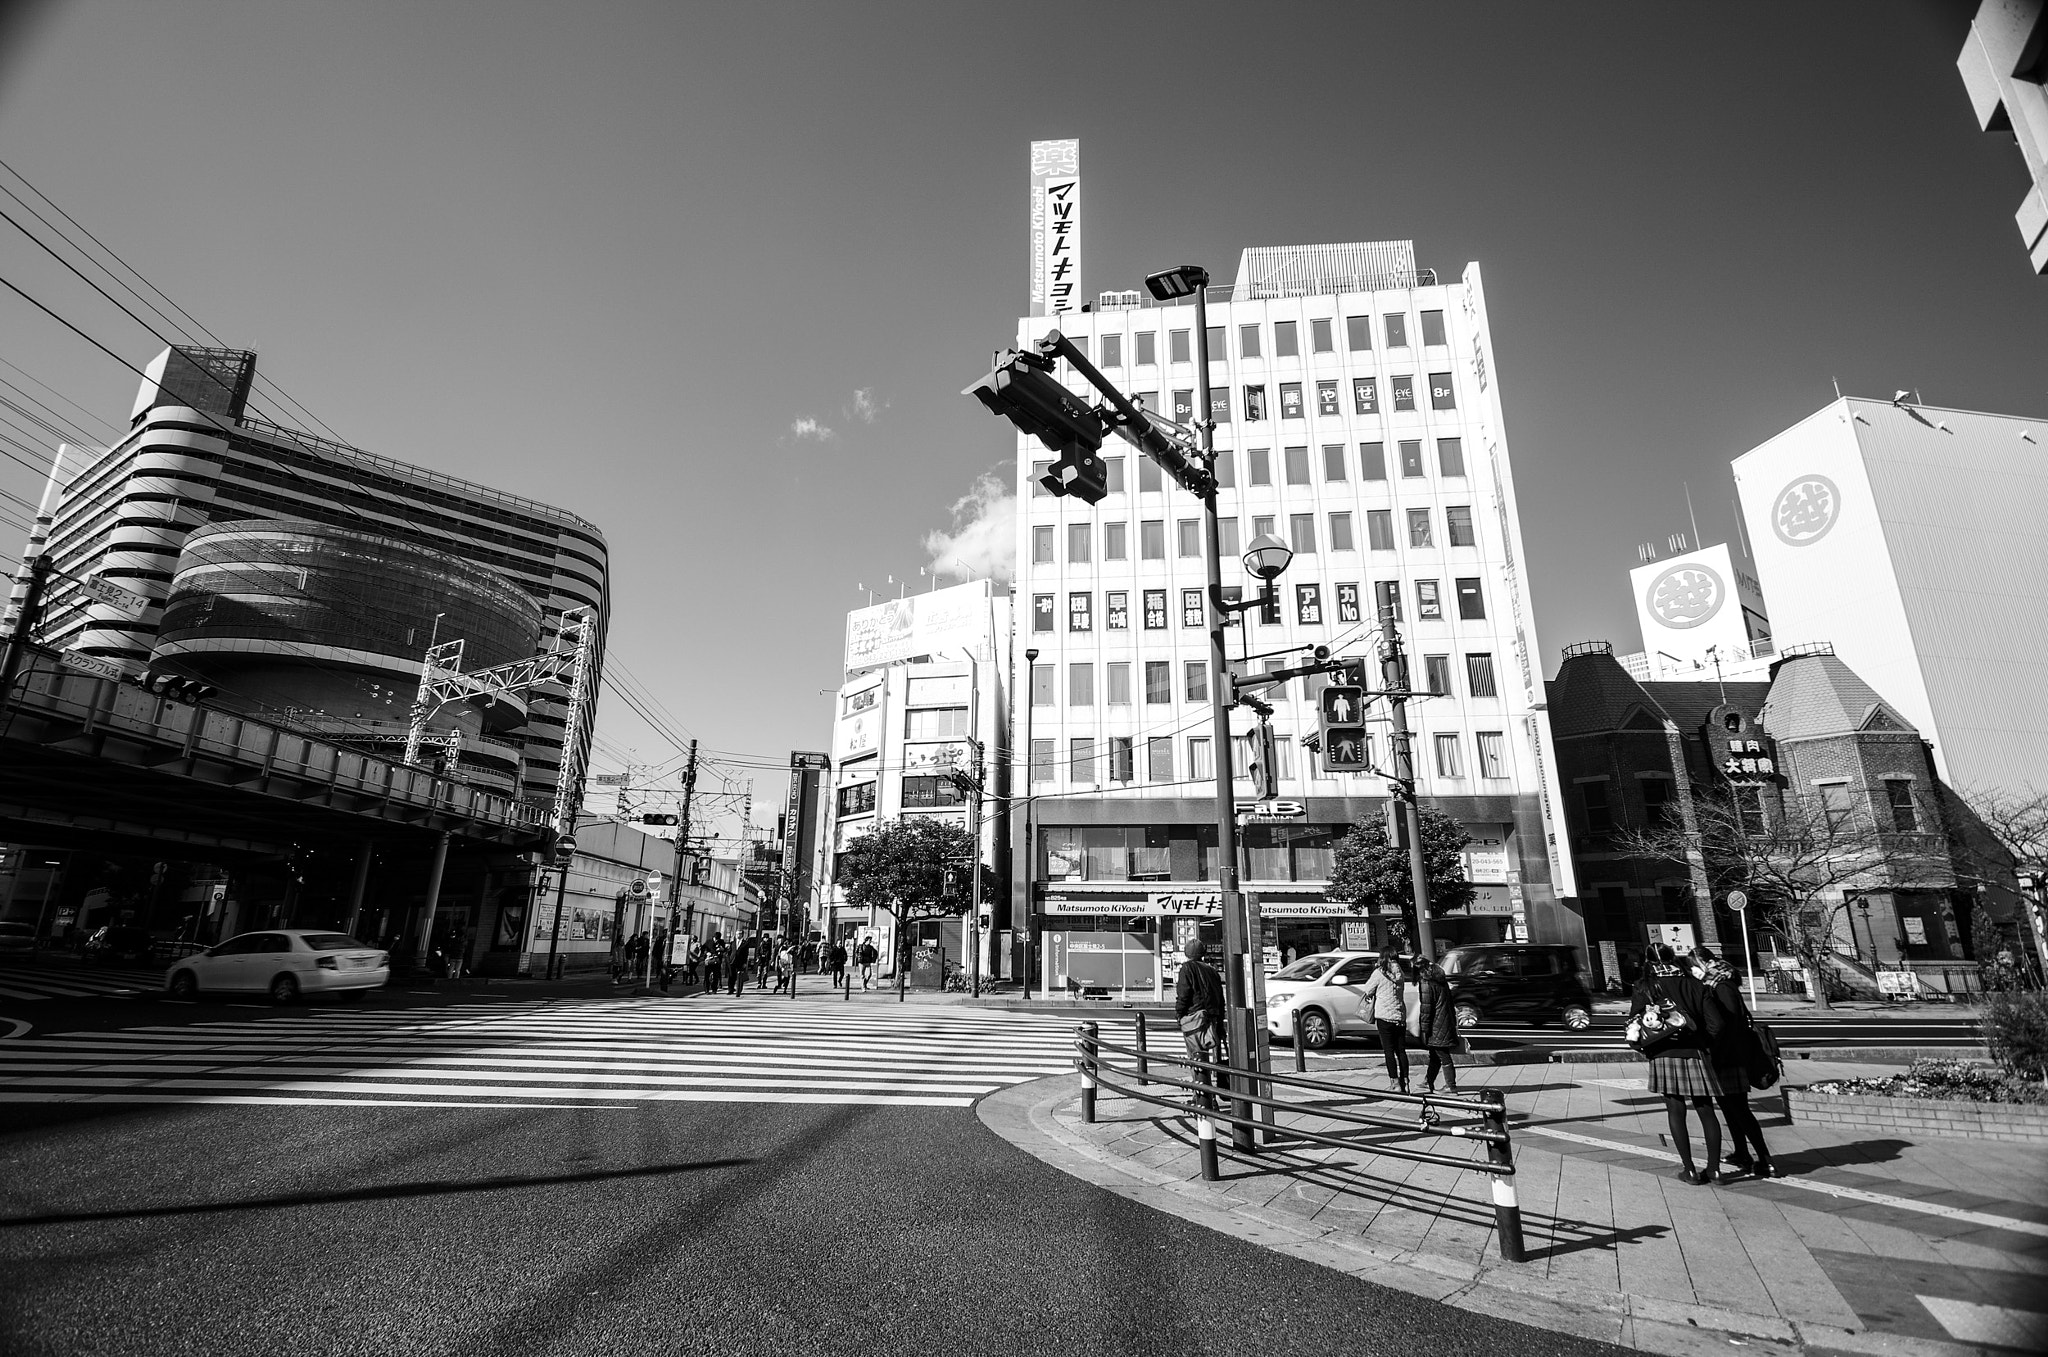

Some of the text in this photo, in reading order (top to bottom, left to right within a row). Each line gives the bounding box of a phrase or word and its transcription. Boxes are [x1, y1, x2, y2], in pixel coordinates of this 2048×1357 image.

[1031, 140, 1077, 176] 薬
[1032, 186, 1045, 303] Matsumoto KiYoshi
[1048, 182, 1077, 312] マツモトキヨシ
[1433, 387, 1451, 398] 8F
[1176, 403, 1191, 414] 8F
[89, 579, 145, 609] 富士見2-14
[1538, 758, 1552, 820] Matsumoto
[1233, 800, 1303, 815] FaB
[1057, 904, 1146, 913] Matsumoto KiYoshi
[1310, 906, 1346, 914] KiYoshi
